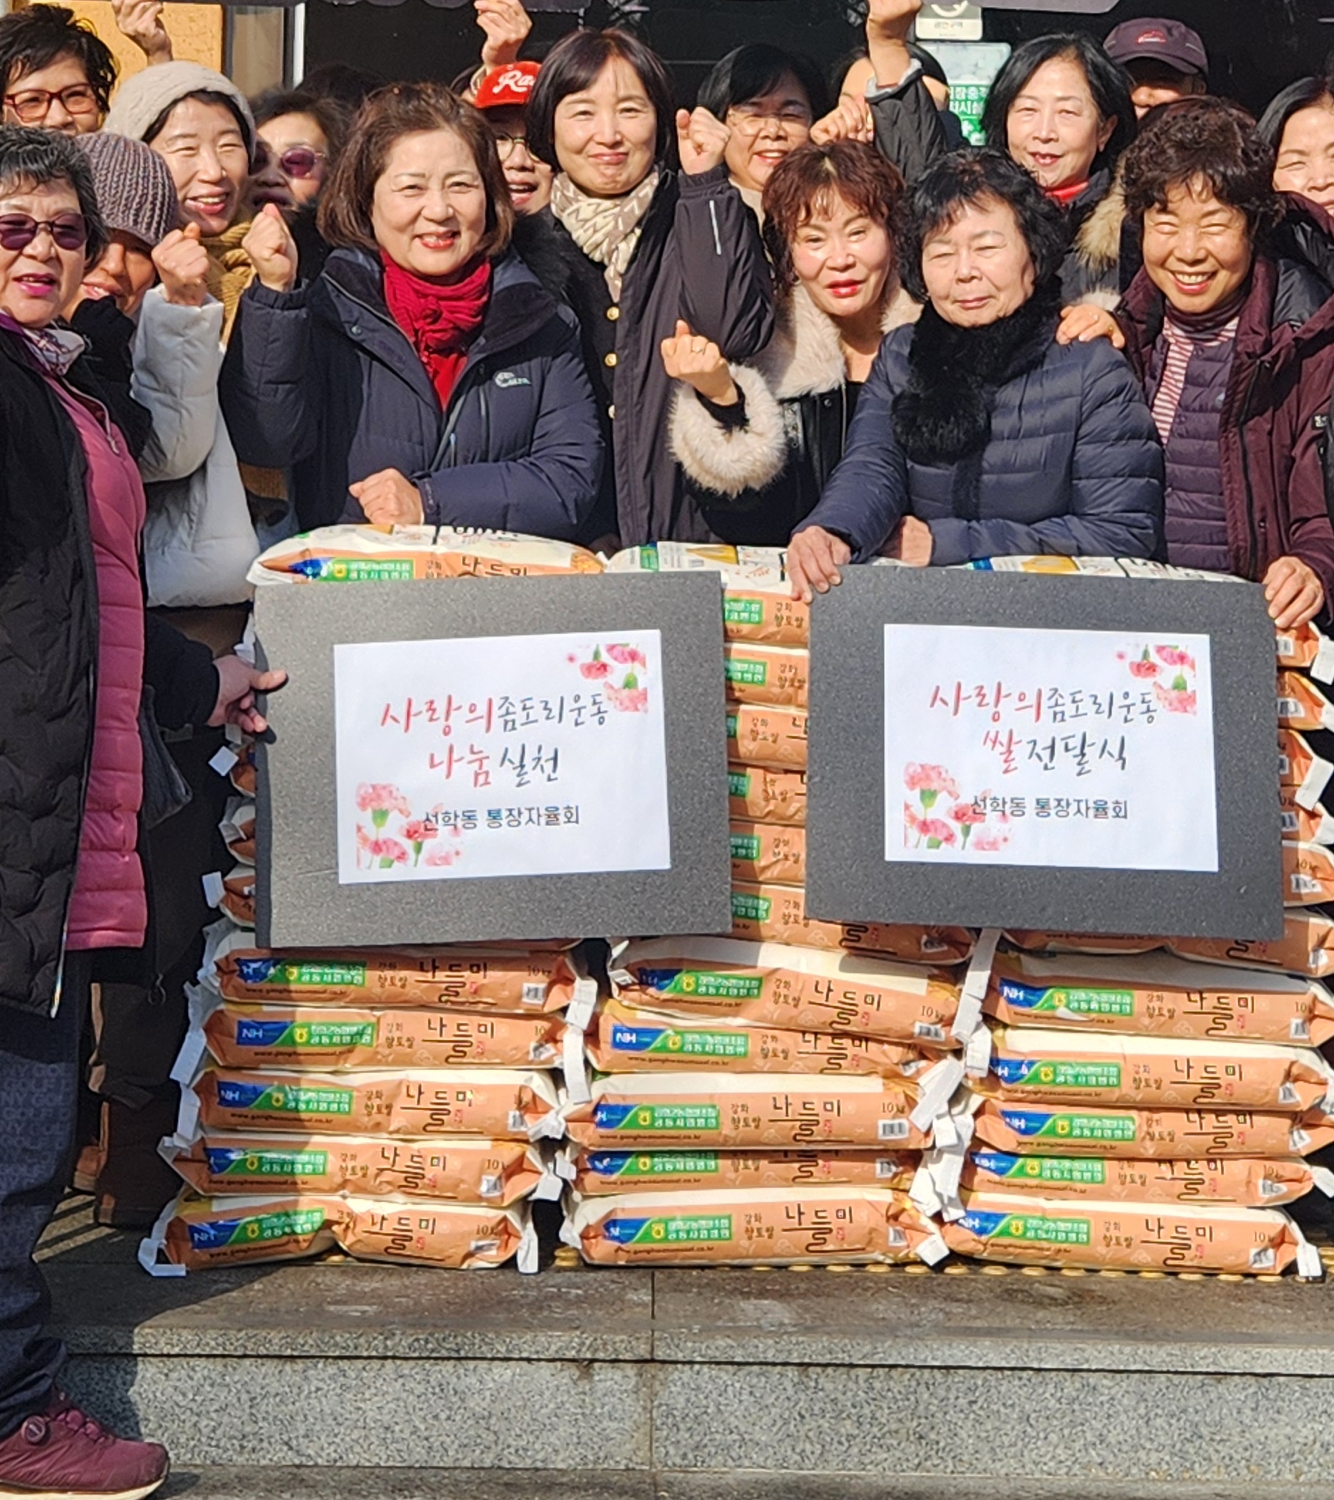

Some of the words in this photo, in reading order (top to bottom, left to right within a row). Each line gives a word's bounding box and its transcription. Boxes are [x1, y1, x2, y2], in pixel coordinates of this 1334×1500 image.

[380, 694, 494, 738] 사랑의
[497, 693, 609, 734] 좀도리운동
[929, 681, 1043, 723] 사랑의
[1046, 686, 1158, 725] 좀도리운동
[429, 744, 491, 787] 나눔
[498, 747, 560, 787] 실천
[982, 730, 1022, 775] 쌀
[1026, 733, 1128, 776] 전달식
[422, 809, 478, 833] 선학동
[486, 805, 580, 829] 통장자율회
[970, 795, 1027, 819] 선학동
[1034, 796, 1128, 820] 통장자율회
[1002, 987, 1025, 1000] NH
[243, 1029, 263, 1040] NH
[616, 1032, 636, 1044] NH
[220, 1089, 240, 1101] NH
[194, 1231, 215, 1243] NH
